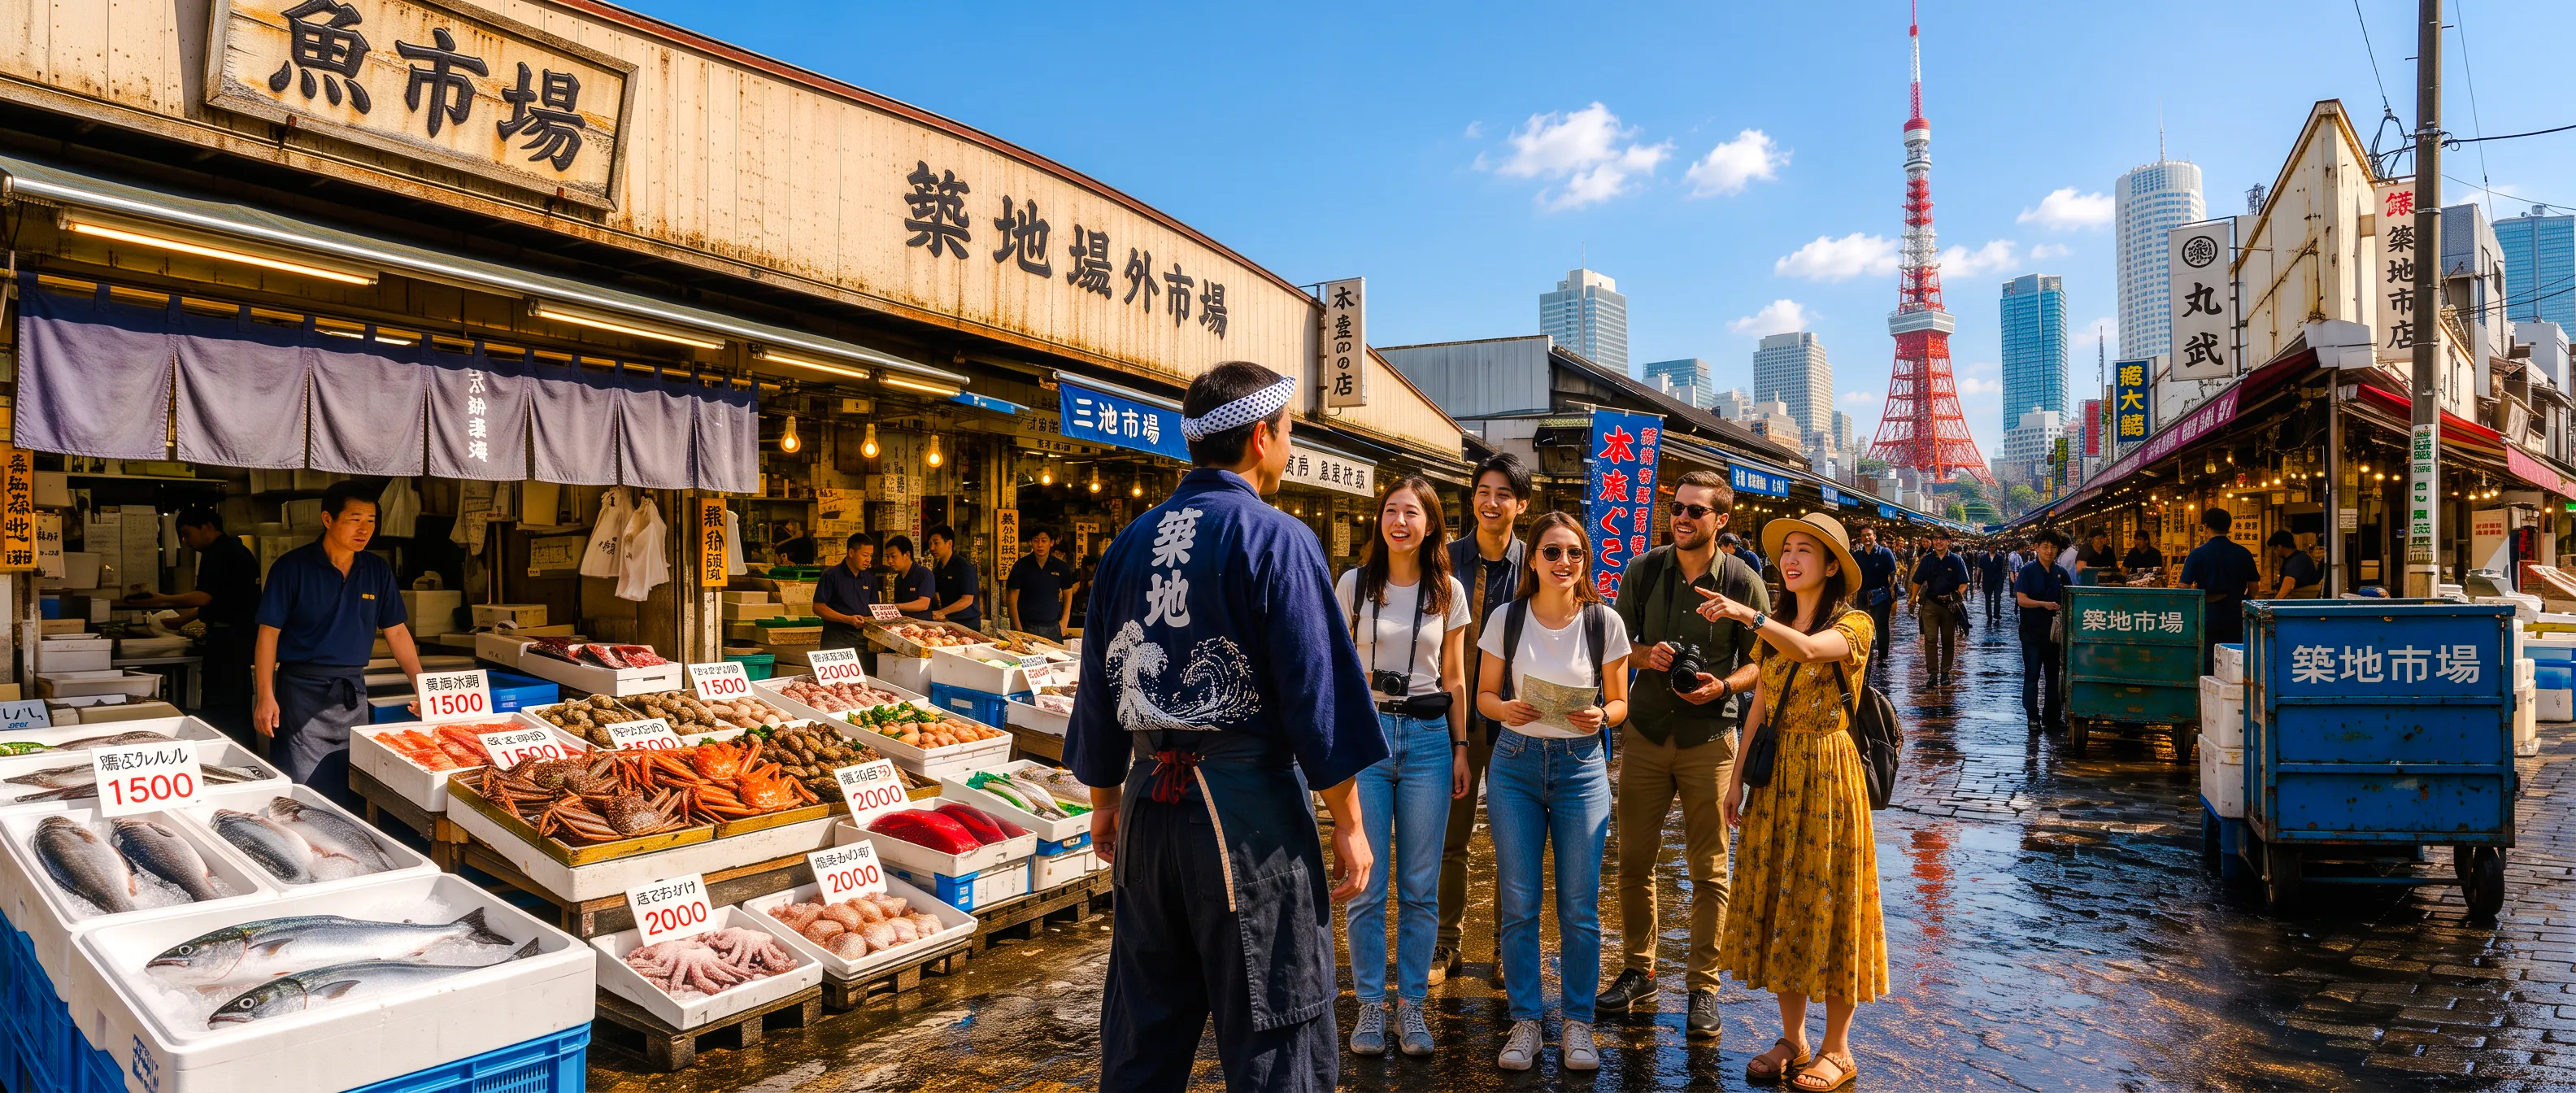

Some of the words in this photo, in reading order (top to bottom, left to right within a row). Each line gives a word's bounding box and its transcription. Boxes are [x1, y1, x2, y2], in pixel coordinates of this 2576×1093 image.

[268, 0, 586, 172] 魚市場
[903, 160, 1228, 340] 築地場外市場
[2182, 282, 2224, 368] 丸武
[1073, 398, 1160, 445] 三池市場
[2082, 608, 2184, 634] 築地市場
[818, 663, 860, 680] 2000
[2291, 644, 2481, 684] 築地市場
[702, 677, 746, 695] 1500
[429, 692, 483, 716] 1500
[108, 773, 194, 805] 1500
[853, 785, 902, 811] 2000
[827, 864, 879, 894] 2000
[645, 901, 707, 936] 2000
